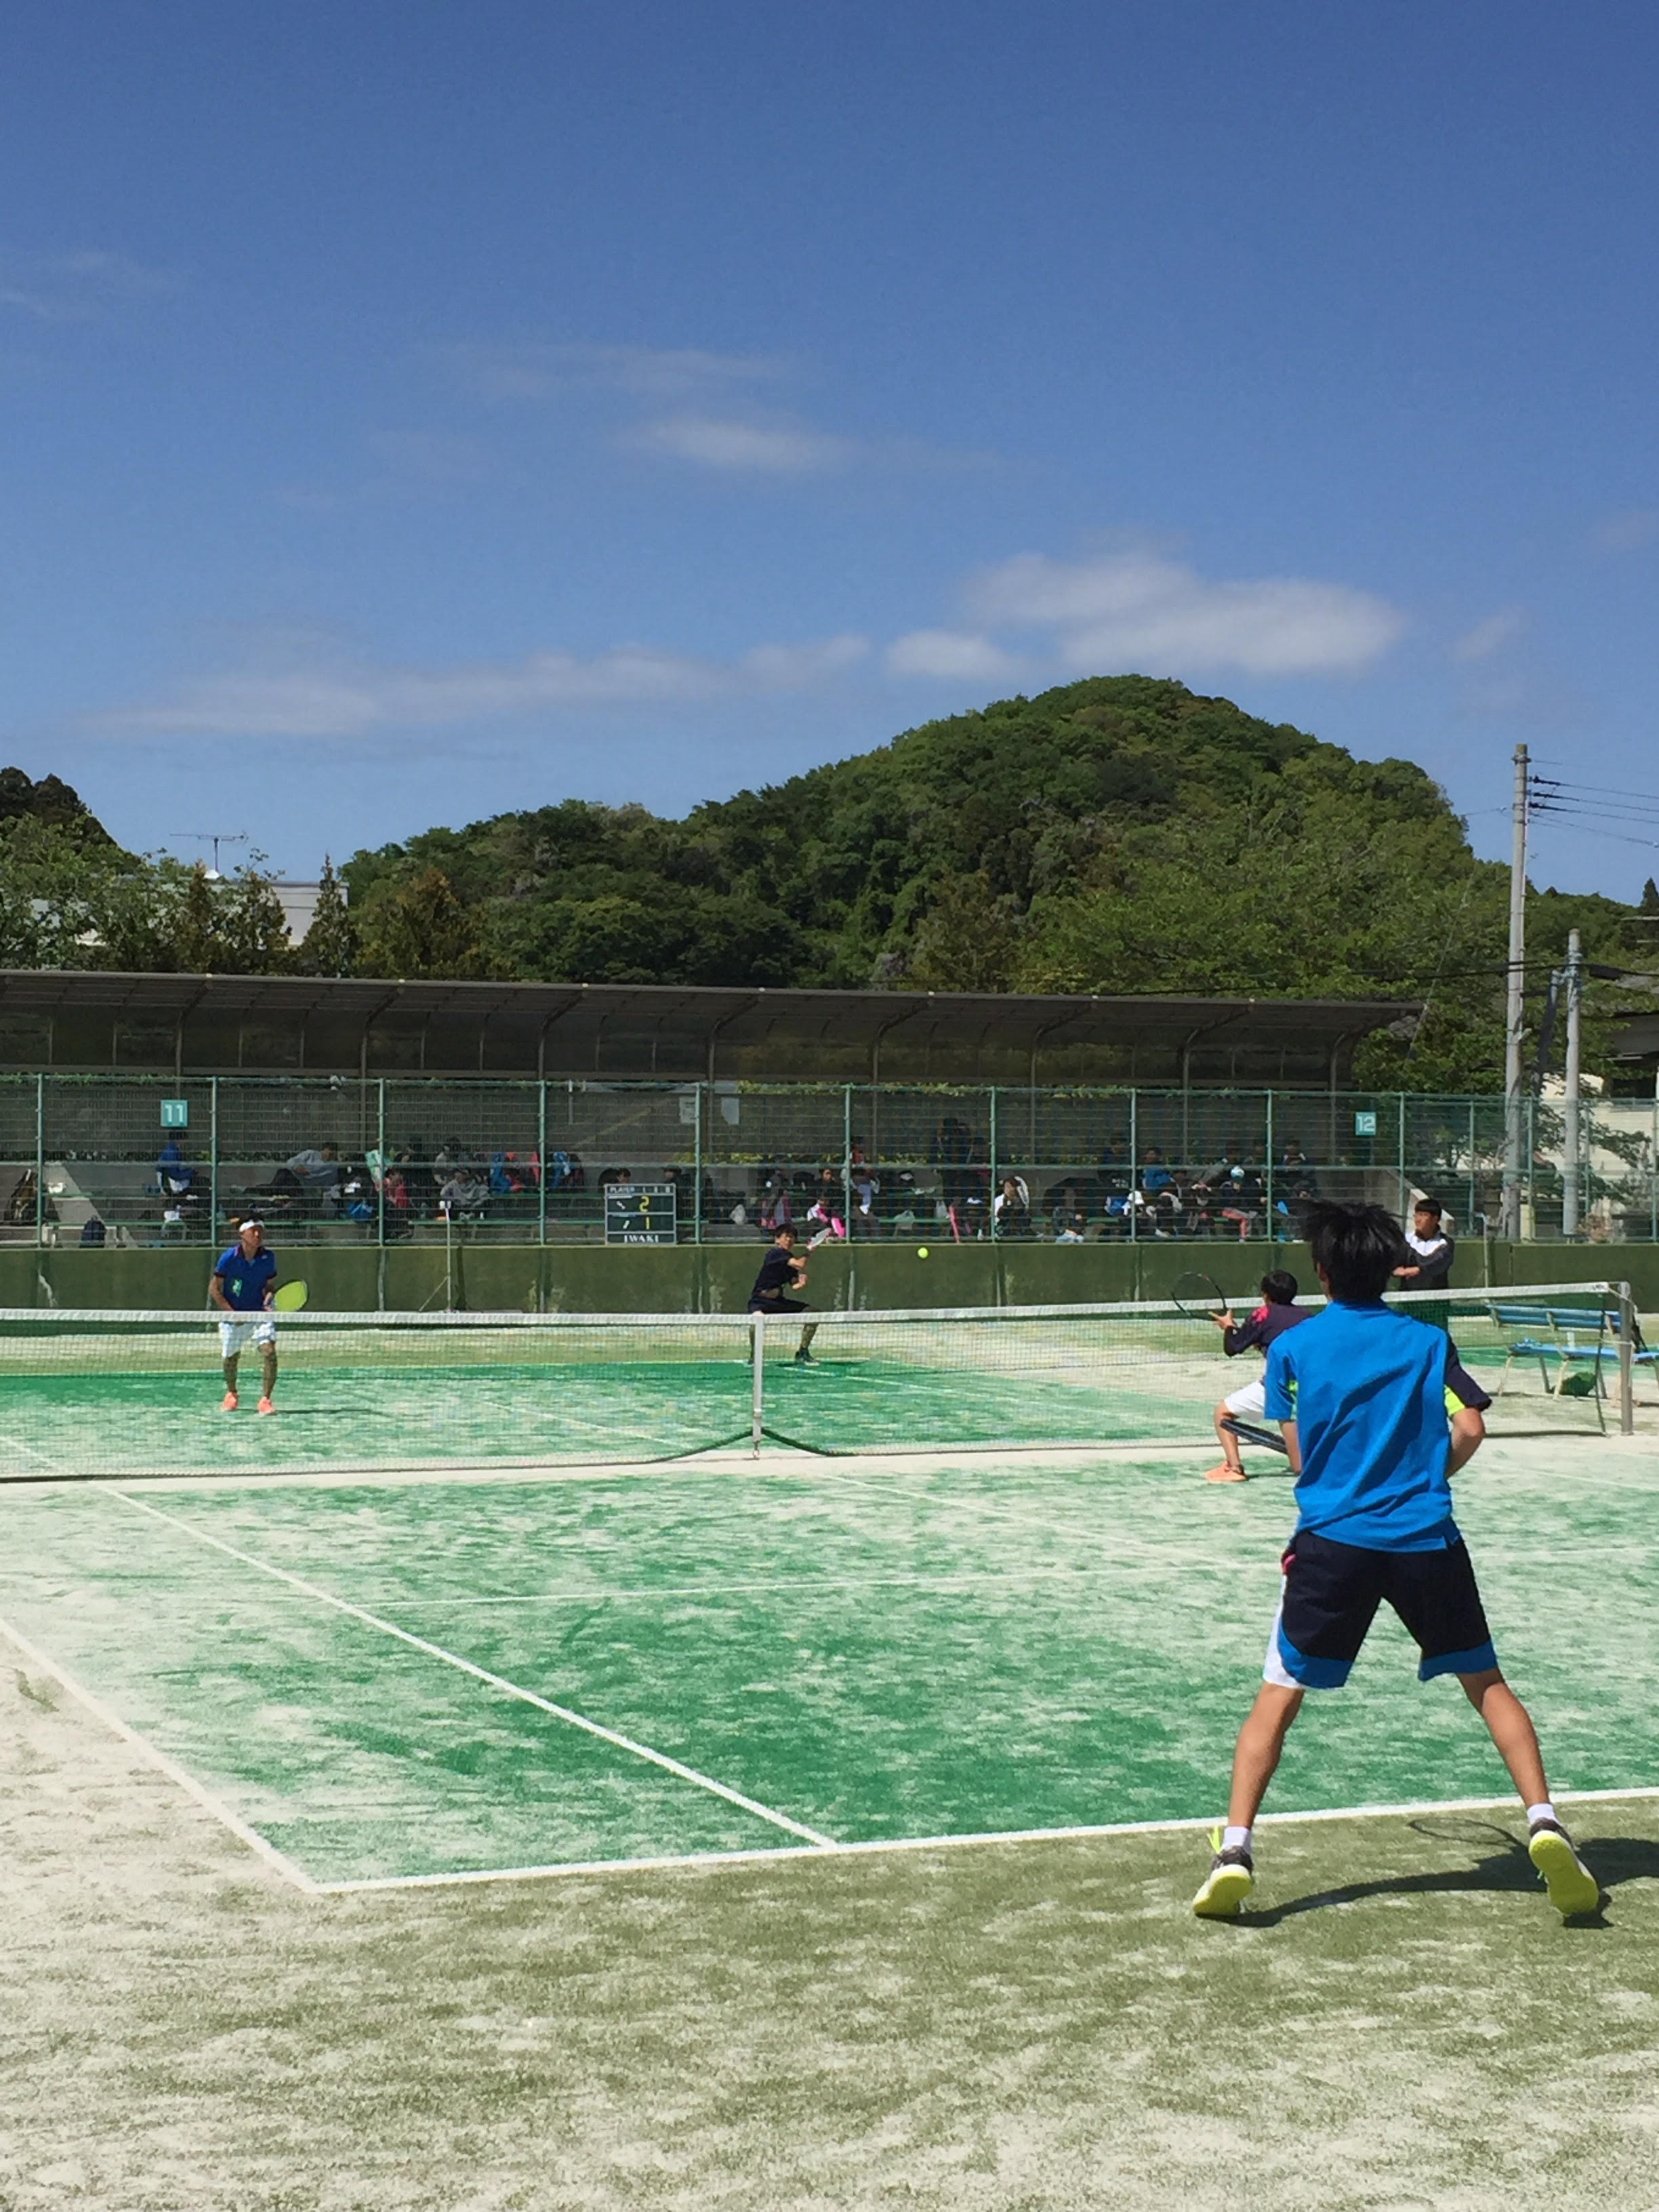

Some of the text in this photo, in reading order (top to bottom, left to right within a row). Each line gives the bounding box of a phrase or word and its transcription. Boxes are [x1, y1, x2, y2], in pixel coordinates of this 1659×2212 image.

[165, 1104, 184, 1122] 11
[1357, 1115, 1375, 1132] 12
[640, 1195, 650, 1212] 2
[624, 1235, 659, 1243] IWAKI
